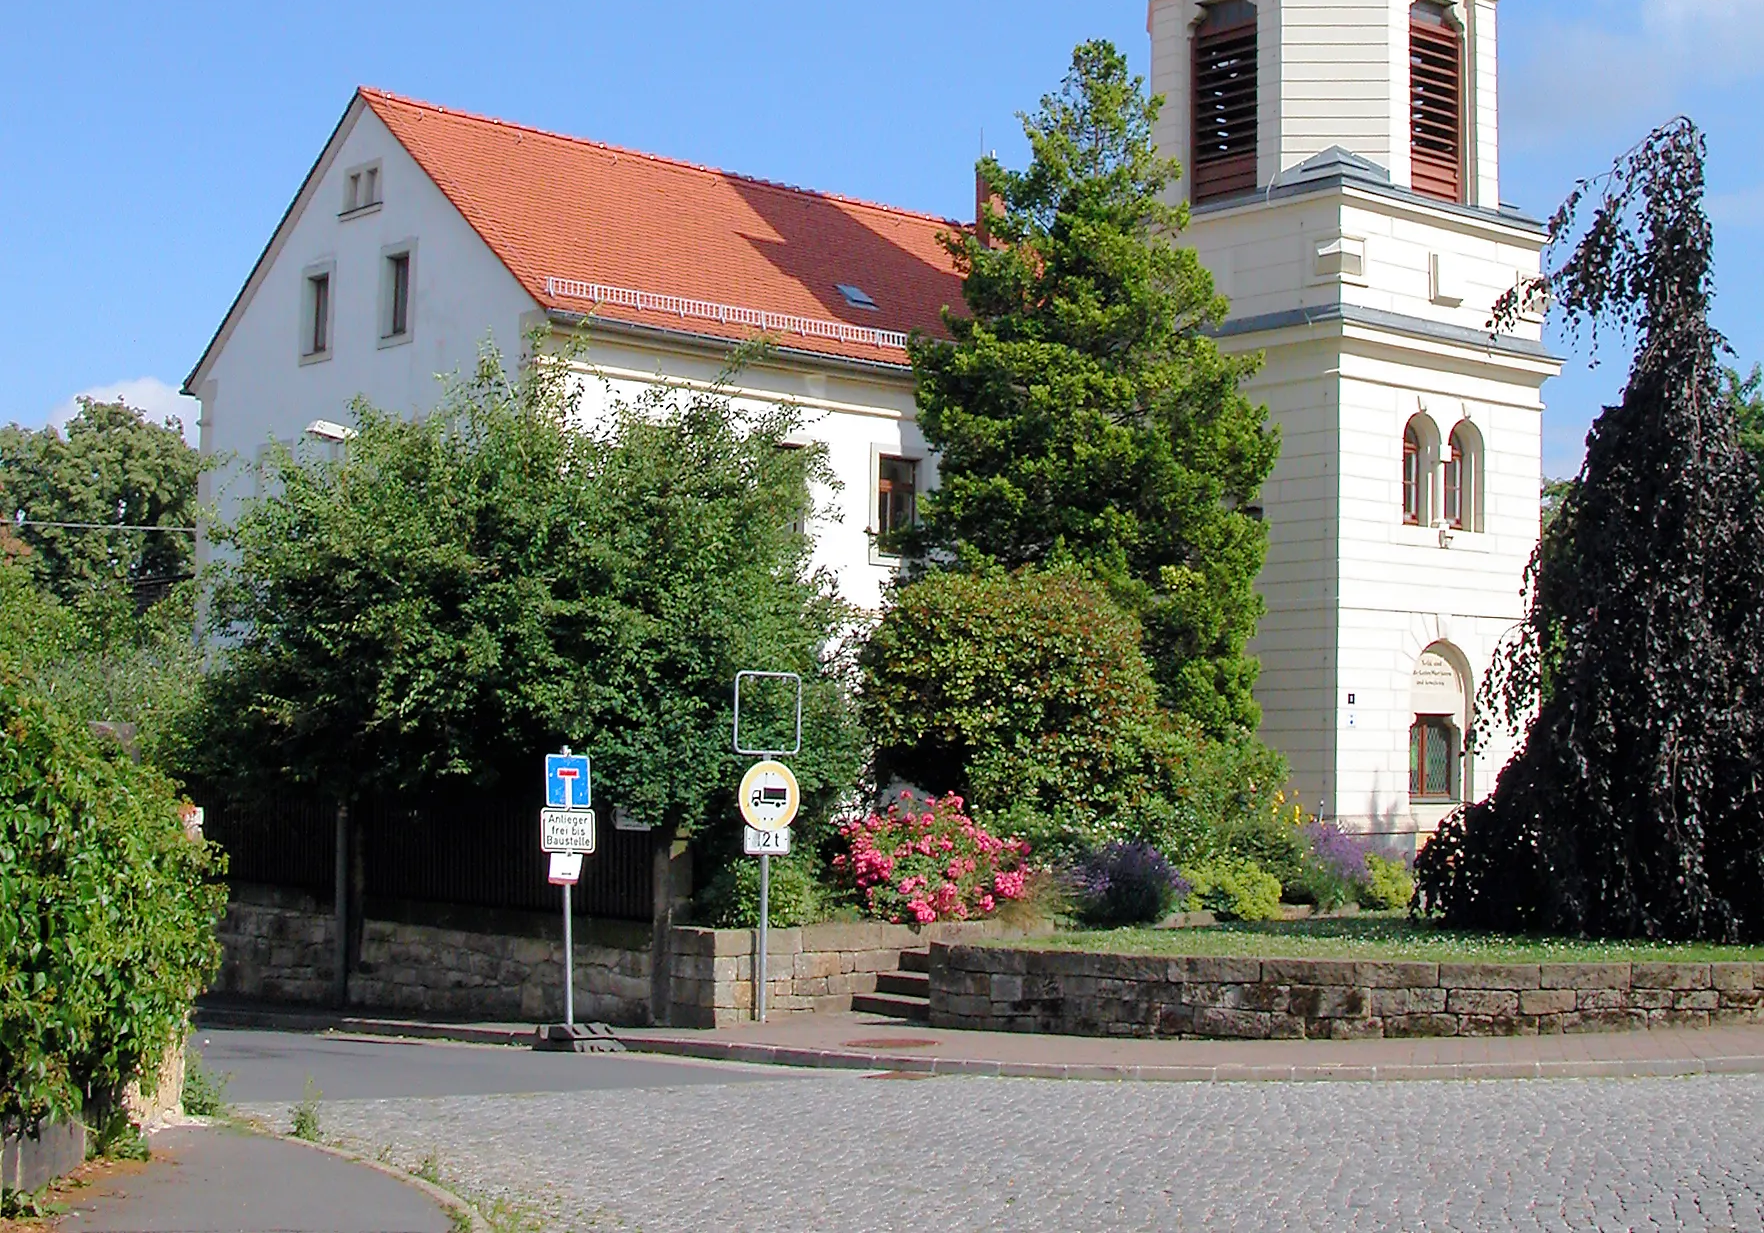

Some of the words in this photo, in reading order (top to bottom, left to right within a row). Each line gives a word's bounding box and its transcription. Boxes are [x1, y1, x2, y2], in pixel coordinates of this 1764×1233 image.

[548, 814, 588, 826] Anlieger
[551, 825, 568, 835] frei
[572, 826, 586, 836] bis
[546, 835, 590, 846] Baustelle
[775, 832, 779, 847] t
